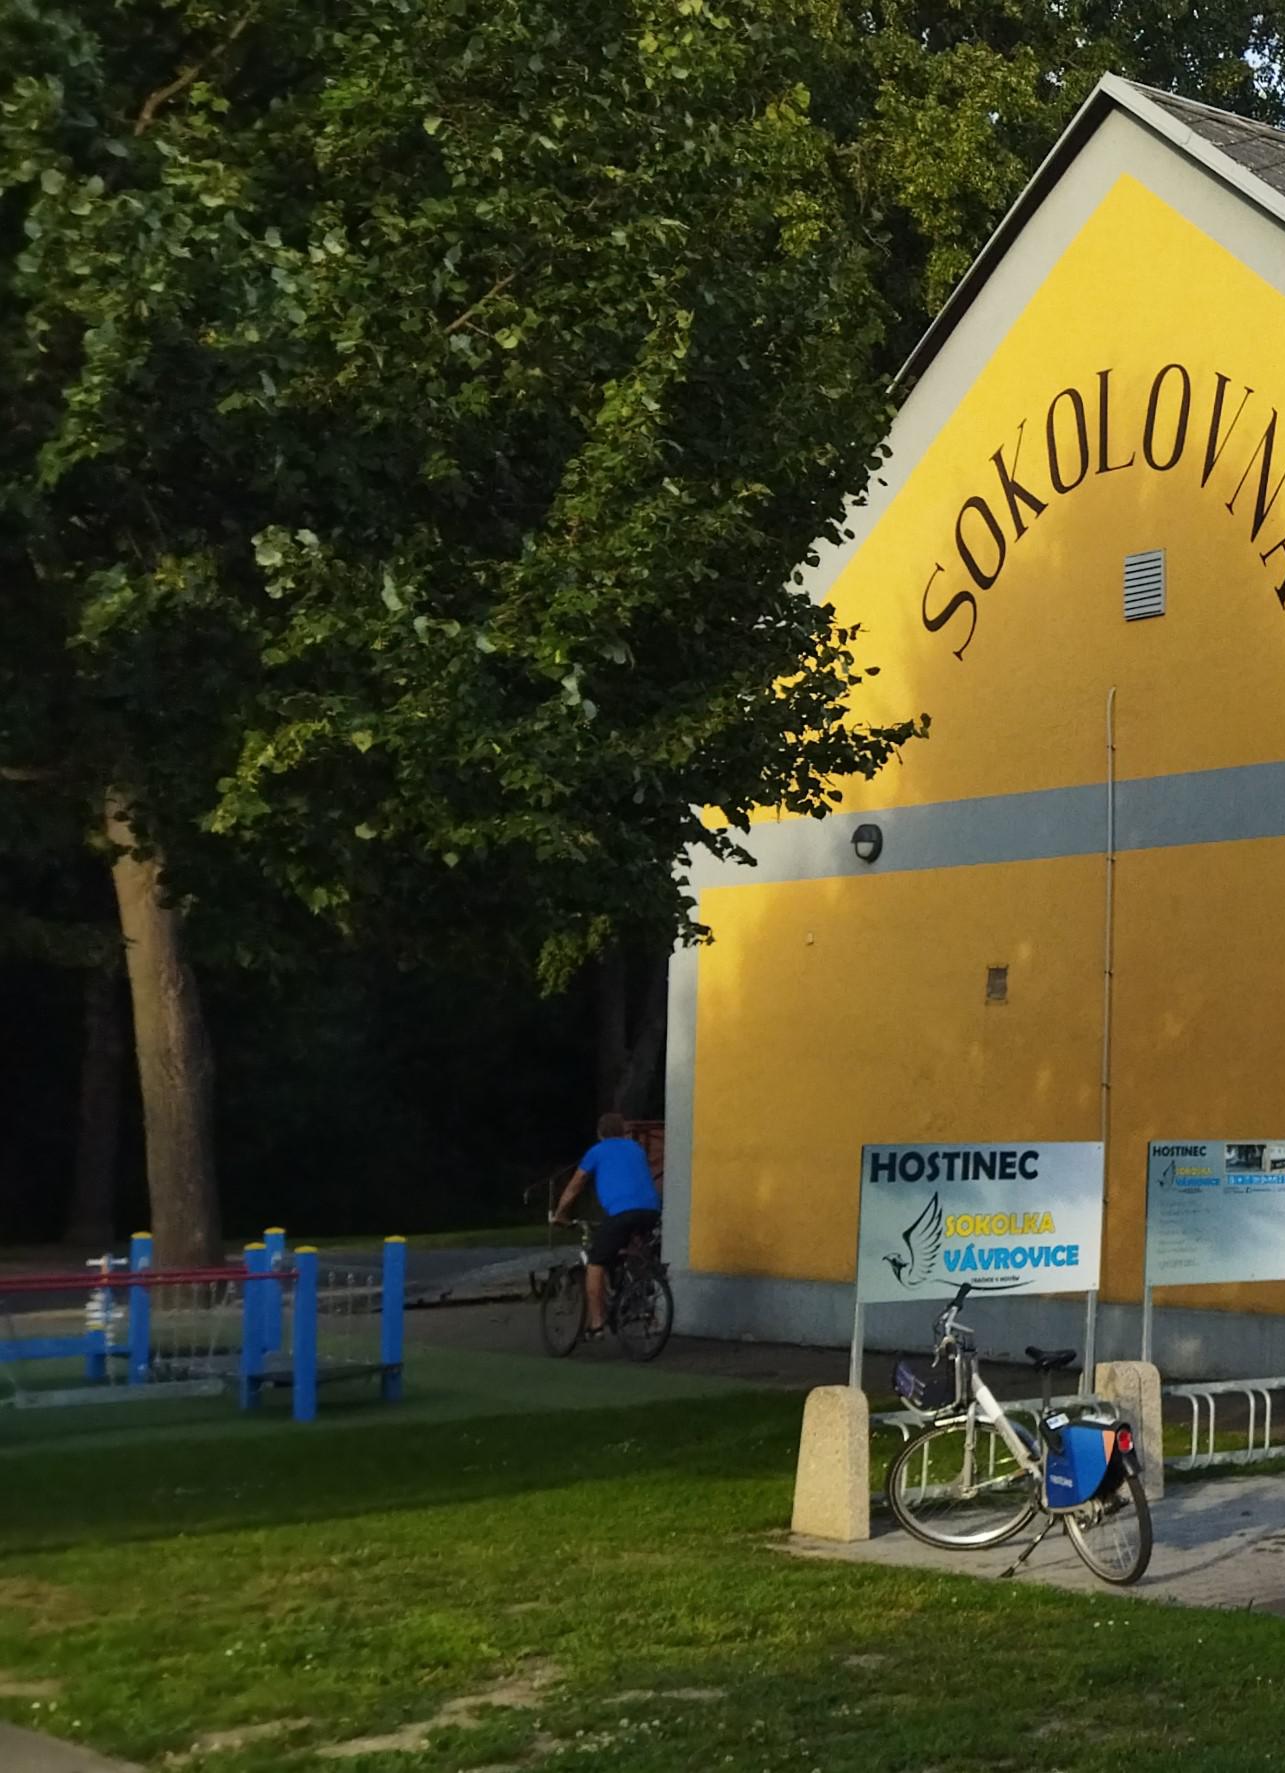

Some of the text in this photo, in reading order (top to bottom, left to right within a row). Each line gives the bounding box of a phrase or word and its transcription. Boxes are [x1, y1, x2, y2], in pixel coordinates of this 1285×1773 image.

[1152, 1145, 1207, 1157] HOSTINEC
[870, 1150, 1040, 1183] HOSTINEC
[944, 1211, 1055, 1238] SOKOLKA
[943, 1243, 1080, 1273] VÁVROVICE
